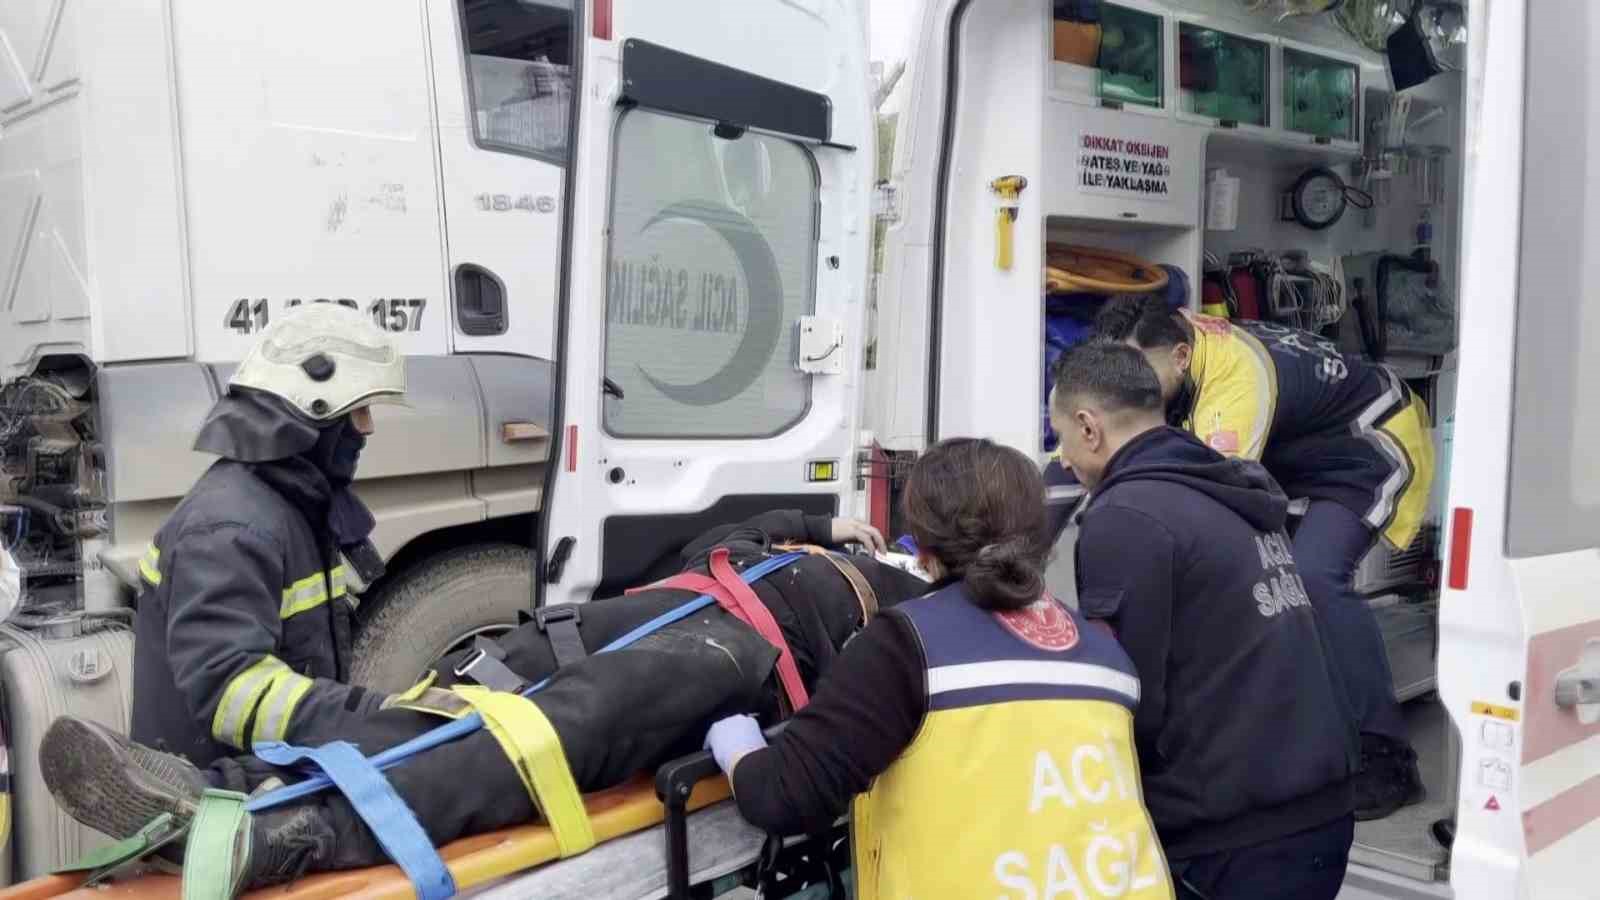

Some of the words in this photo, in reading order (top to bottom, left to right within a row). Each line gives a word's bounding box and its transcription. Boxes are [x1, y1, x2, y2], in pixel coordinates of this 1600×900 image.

[1123, 159, 1139, 174] VE
[474, 193, 556, 214] 1846
[224, 298, 270, 335] 41
[366, 298, 427, 332] 157
[1027, 730, 1134, 815] ACİ
